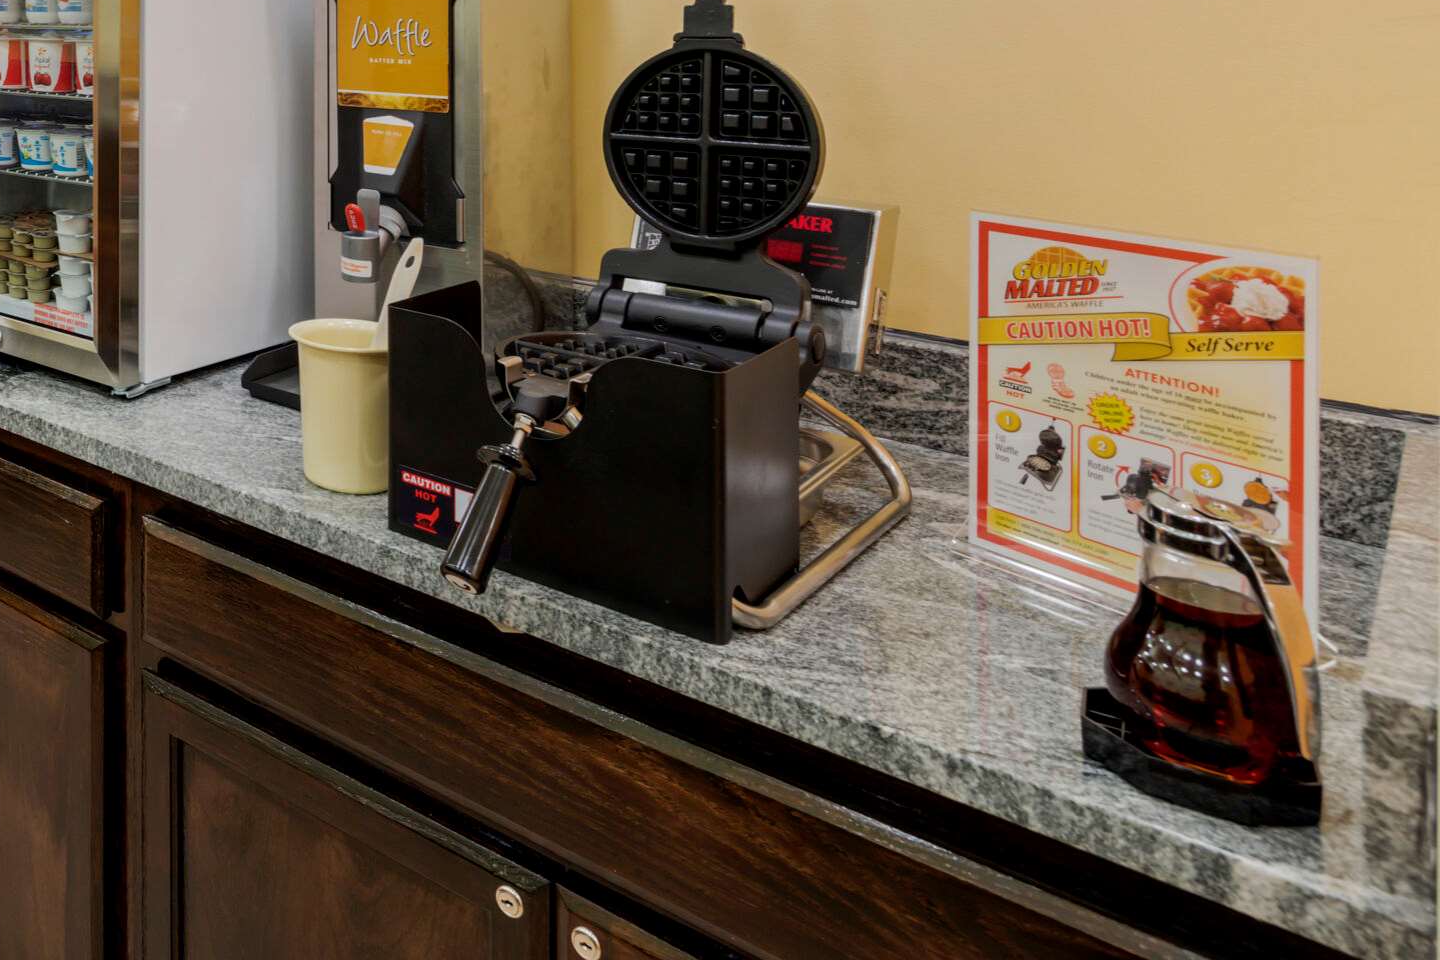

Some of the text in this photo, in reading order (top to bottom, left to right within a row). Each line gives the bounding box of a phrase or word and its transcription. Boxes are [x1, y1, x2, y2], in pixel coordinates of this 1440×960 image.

[351, 15, 433, 56] Waffle
[784, 214, 833, 234] AKER
[1012, 259, 1109, 281] GOLDEN
[1004, 276, 1100, 300] MALTED
[1070, 300, 1104, 308] WAFFLE
[1006, 319, 1152, 340] CAUTION HOT!
[1185, 337, 1275, 357] Self Serve
[1124, 367, 1220, 398] ATTENTION!
[1006, 390, 1025, 400] HOT
[402, 471, 452, 495] CAUTION
[415, 488, 437, 503] HOT
